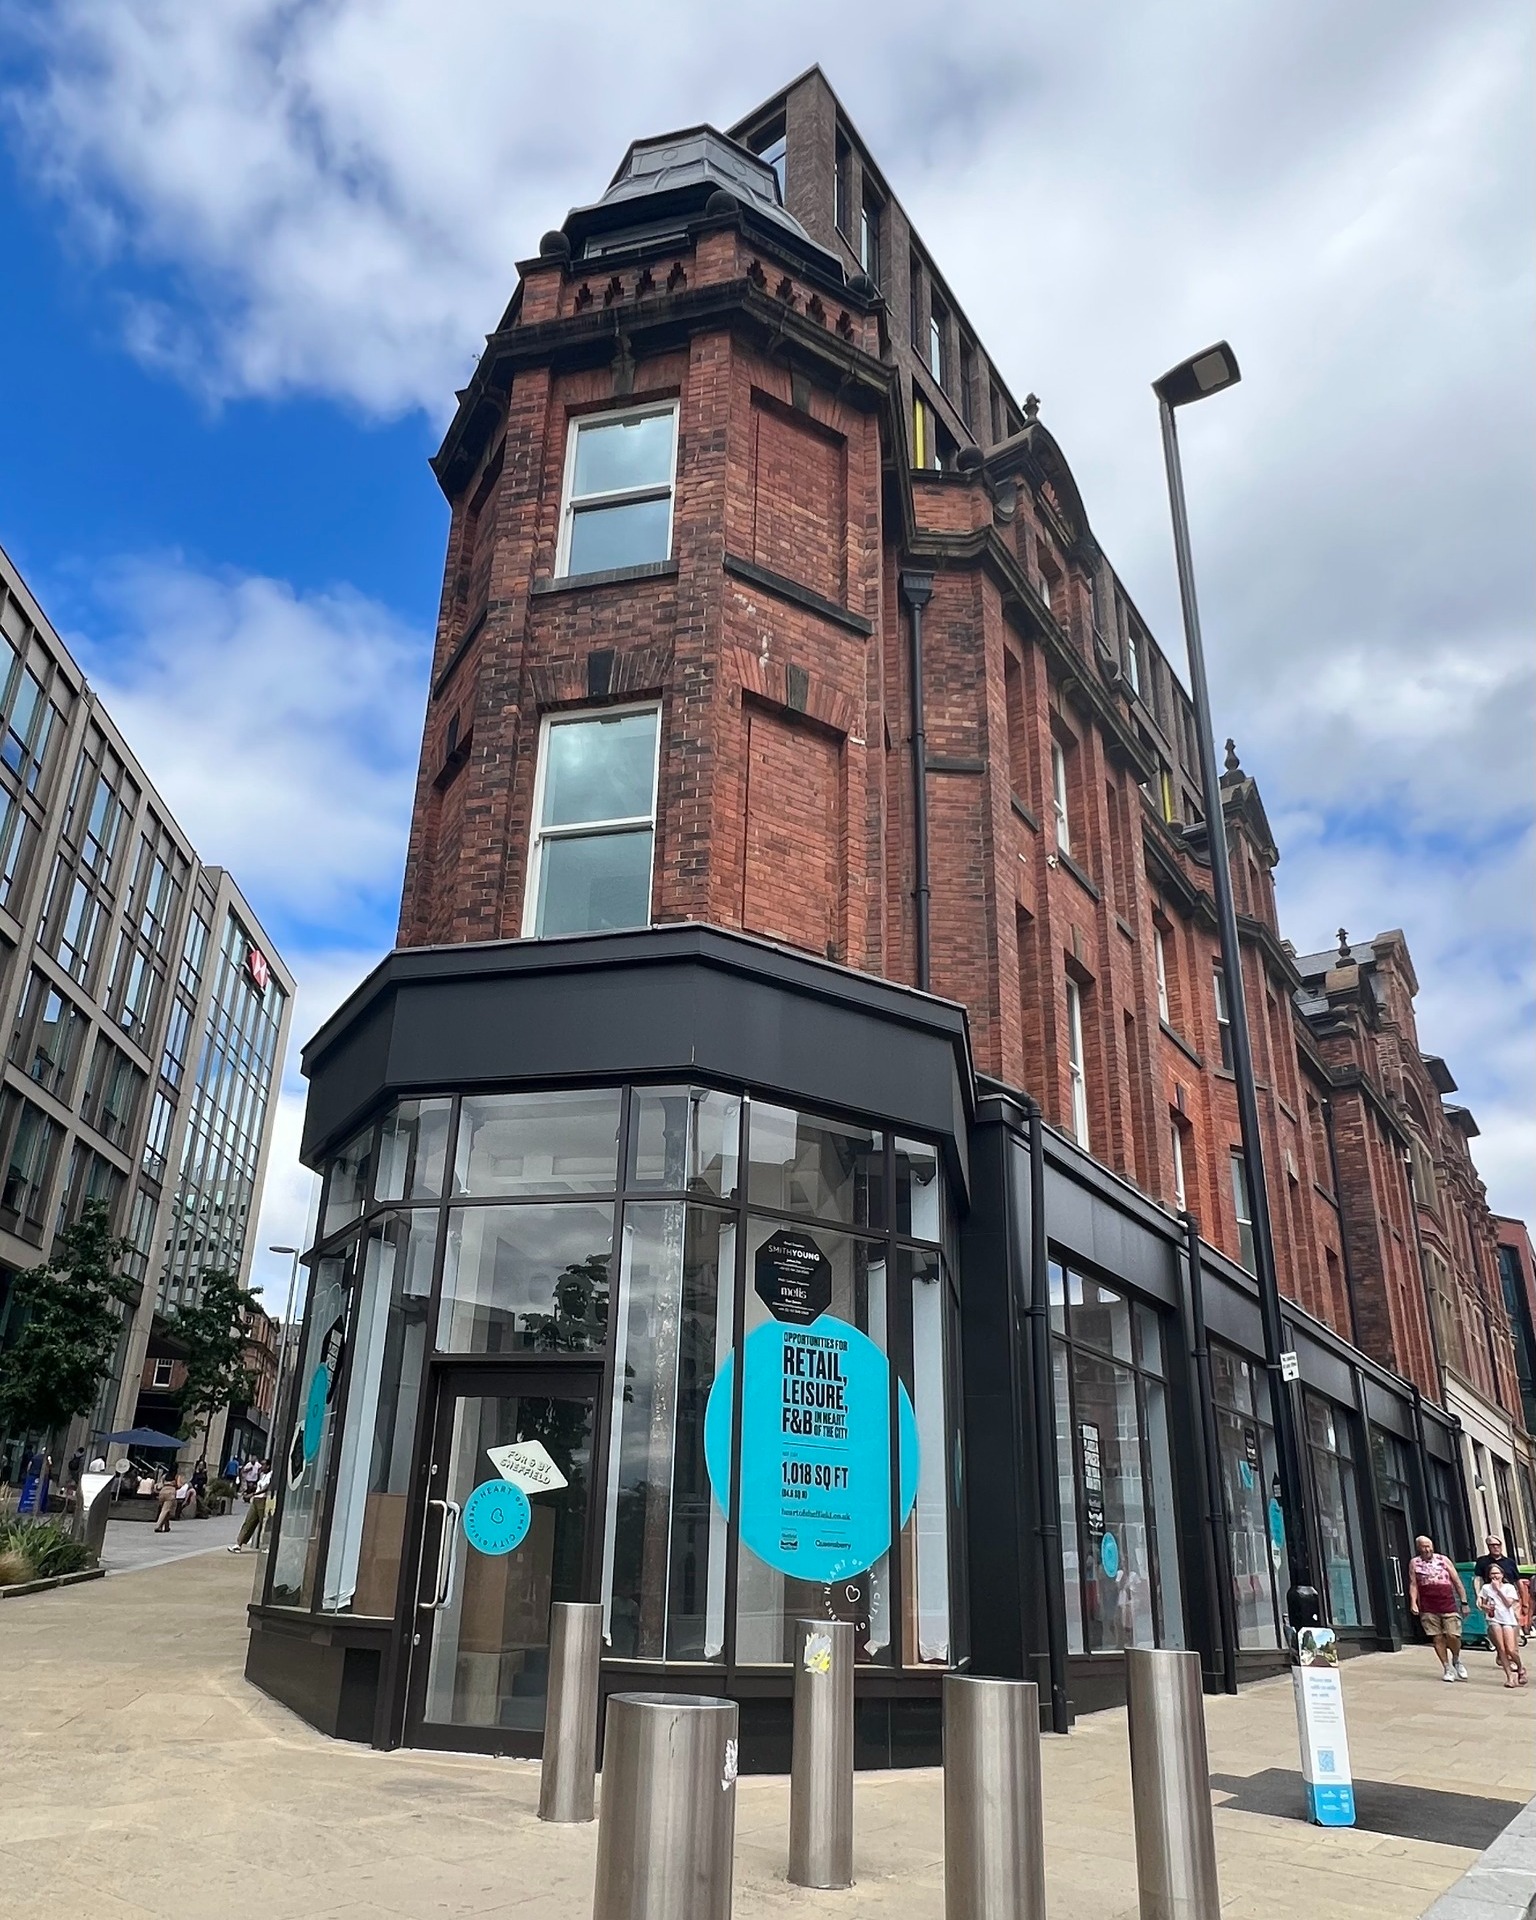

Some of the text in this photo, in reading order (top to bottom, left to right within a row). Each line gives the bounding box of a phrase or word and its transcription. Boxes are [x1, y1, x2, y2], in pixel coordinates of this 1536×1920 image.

[768, 1244, 820, 1262] SMITHYOUNG
[783, 1331, 848, 1351] OPPORTUNITIES FOR
[783, 1344, 848, 1387] RETAIL,
[782, 1377, 849, 1414] LEISURE,
[782, 1406, 813, 1435] F&B
[813, 1424, 848, 1440] OF THE CITY
[814, 1410, 846, 1426] IN HEART
[499, 1458, 551, 1486] SHEFFIELD
[507, 1450, 528, 1466] FOR
[538, 1461, 552, 1474] BY
[781, 1461, 849, 1491] 1,018 SQ FT
[480, 1485, 526, 1548] HEART OF THE CITY
[851, 1558, 863, 1568] OF
[867, 1592, 881, 1623] CITY
